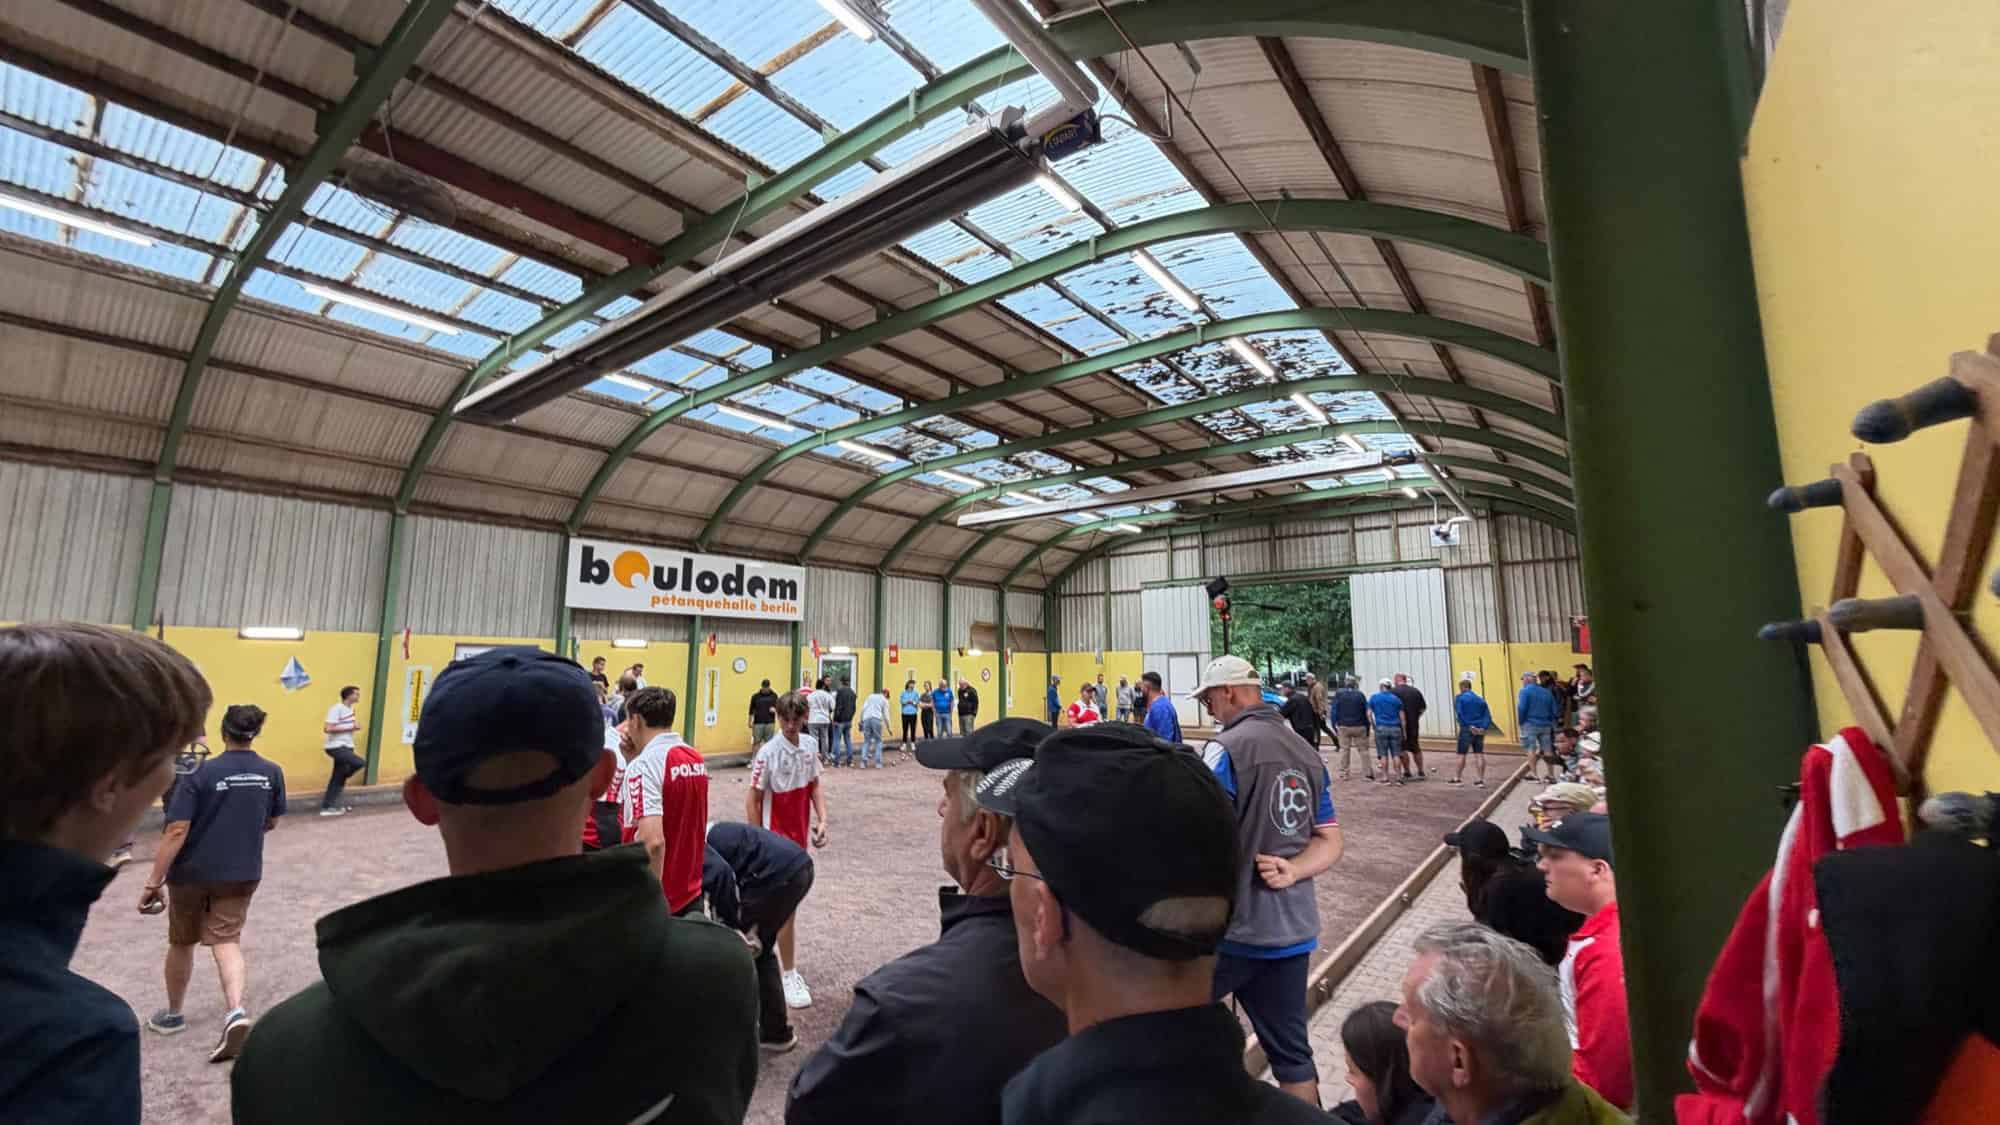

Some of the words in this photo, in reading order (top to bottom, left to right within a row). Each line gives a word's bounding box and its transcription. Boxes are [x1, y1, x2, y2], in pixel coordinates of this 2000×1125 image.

[579, 545, 798, 600] boulodom
[760, 600, 797, 614] berlin
[670, 763, 708, 781] POLSK
